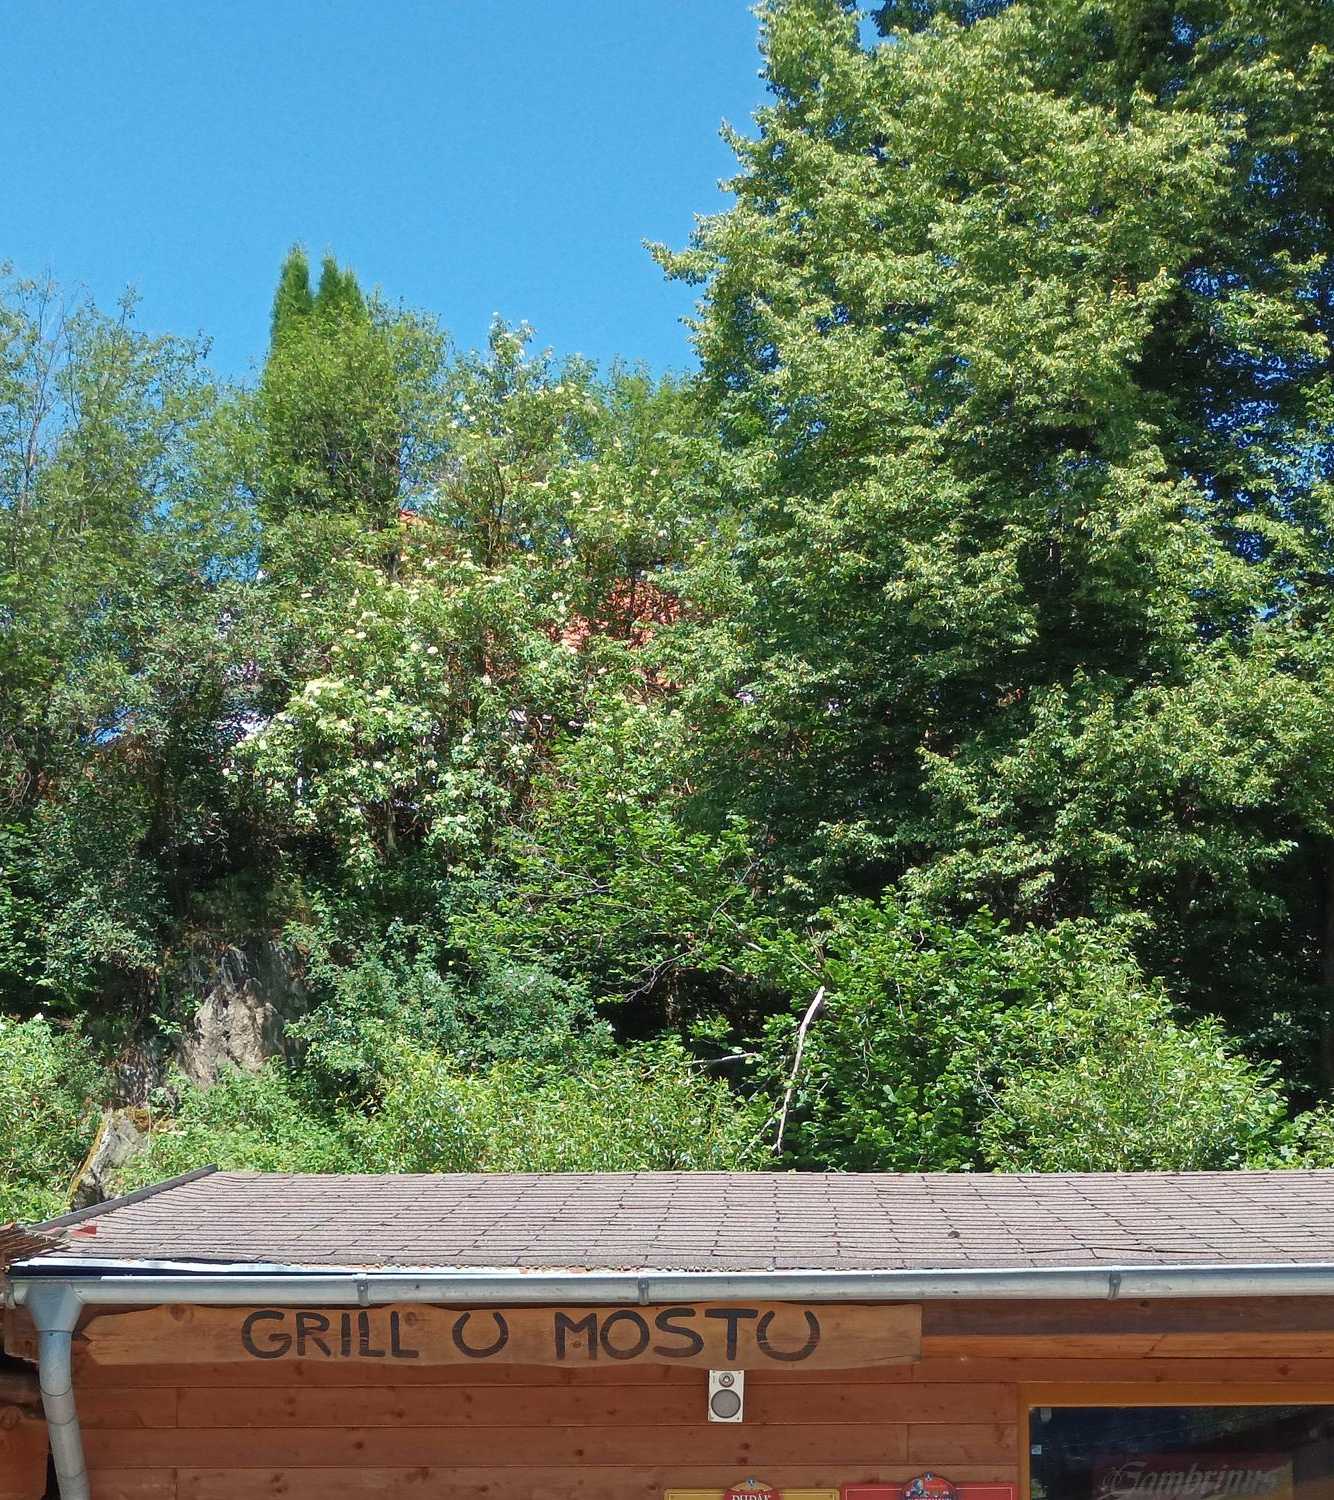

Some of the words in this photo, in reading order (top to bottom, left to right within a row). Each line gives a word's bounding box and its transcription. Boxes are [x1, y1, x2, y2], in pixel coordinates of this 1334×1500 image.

[241, 1309, 420, 1360] GRILL
[452, 1309, 511, 1359] U
[554, 1307, 822, 1363] MOSTU
[1095, 1460, 1279, 1500] Gambrinus
